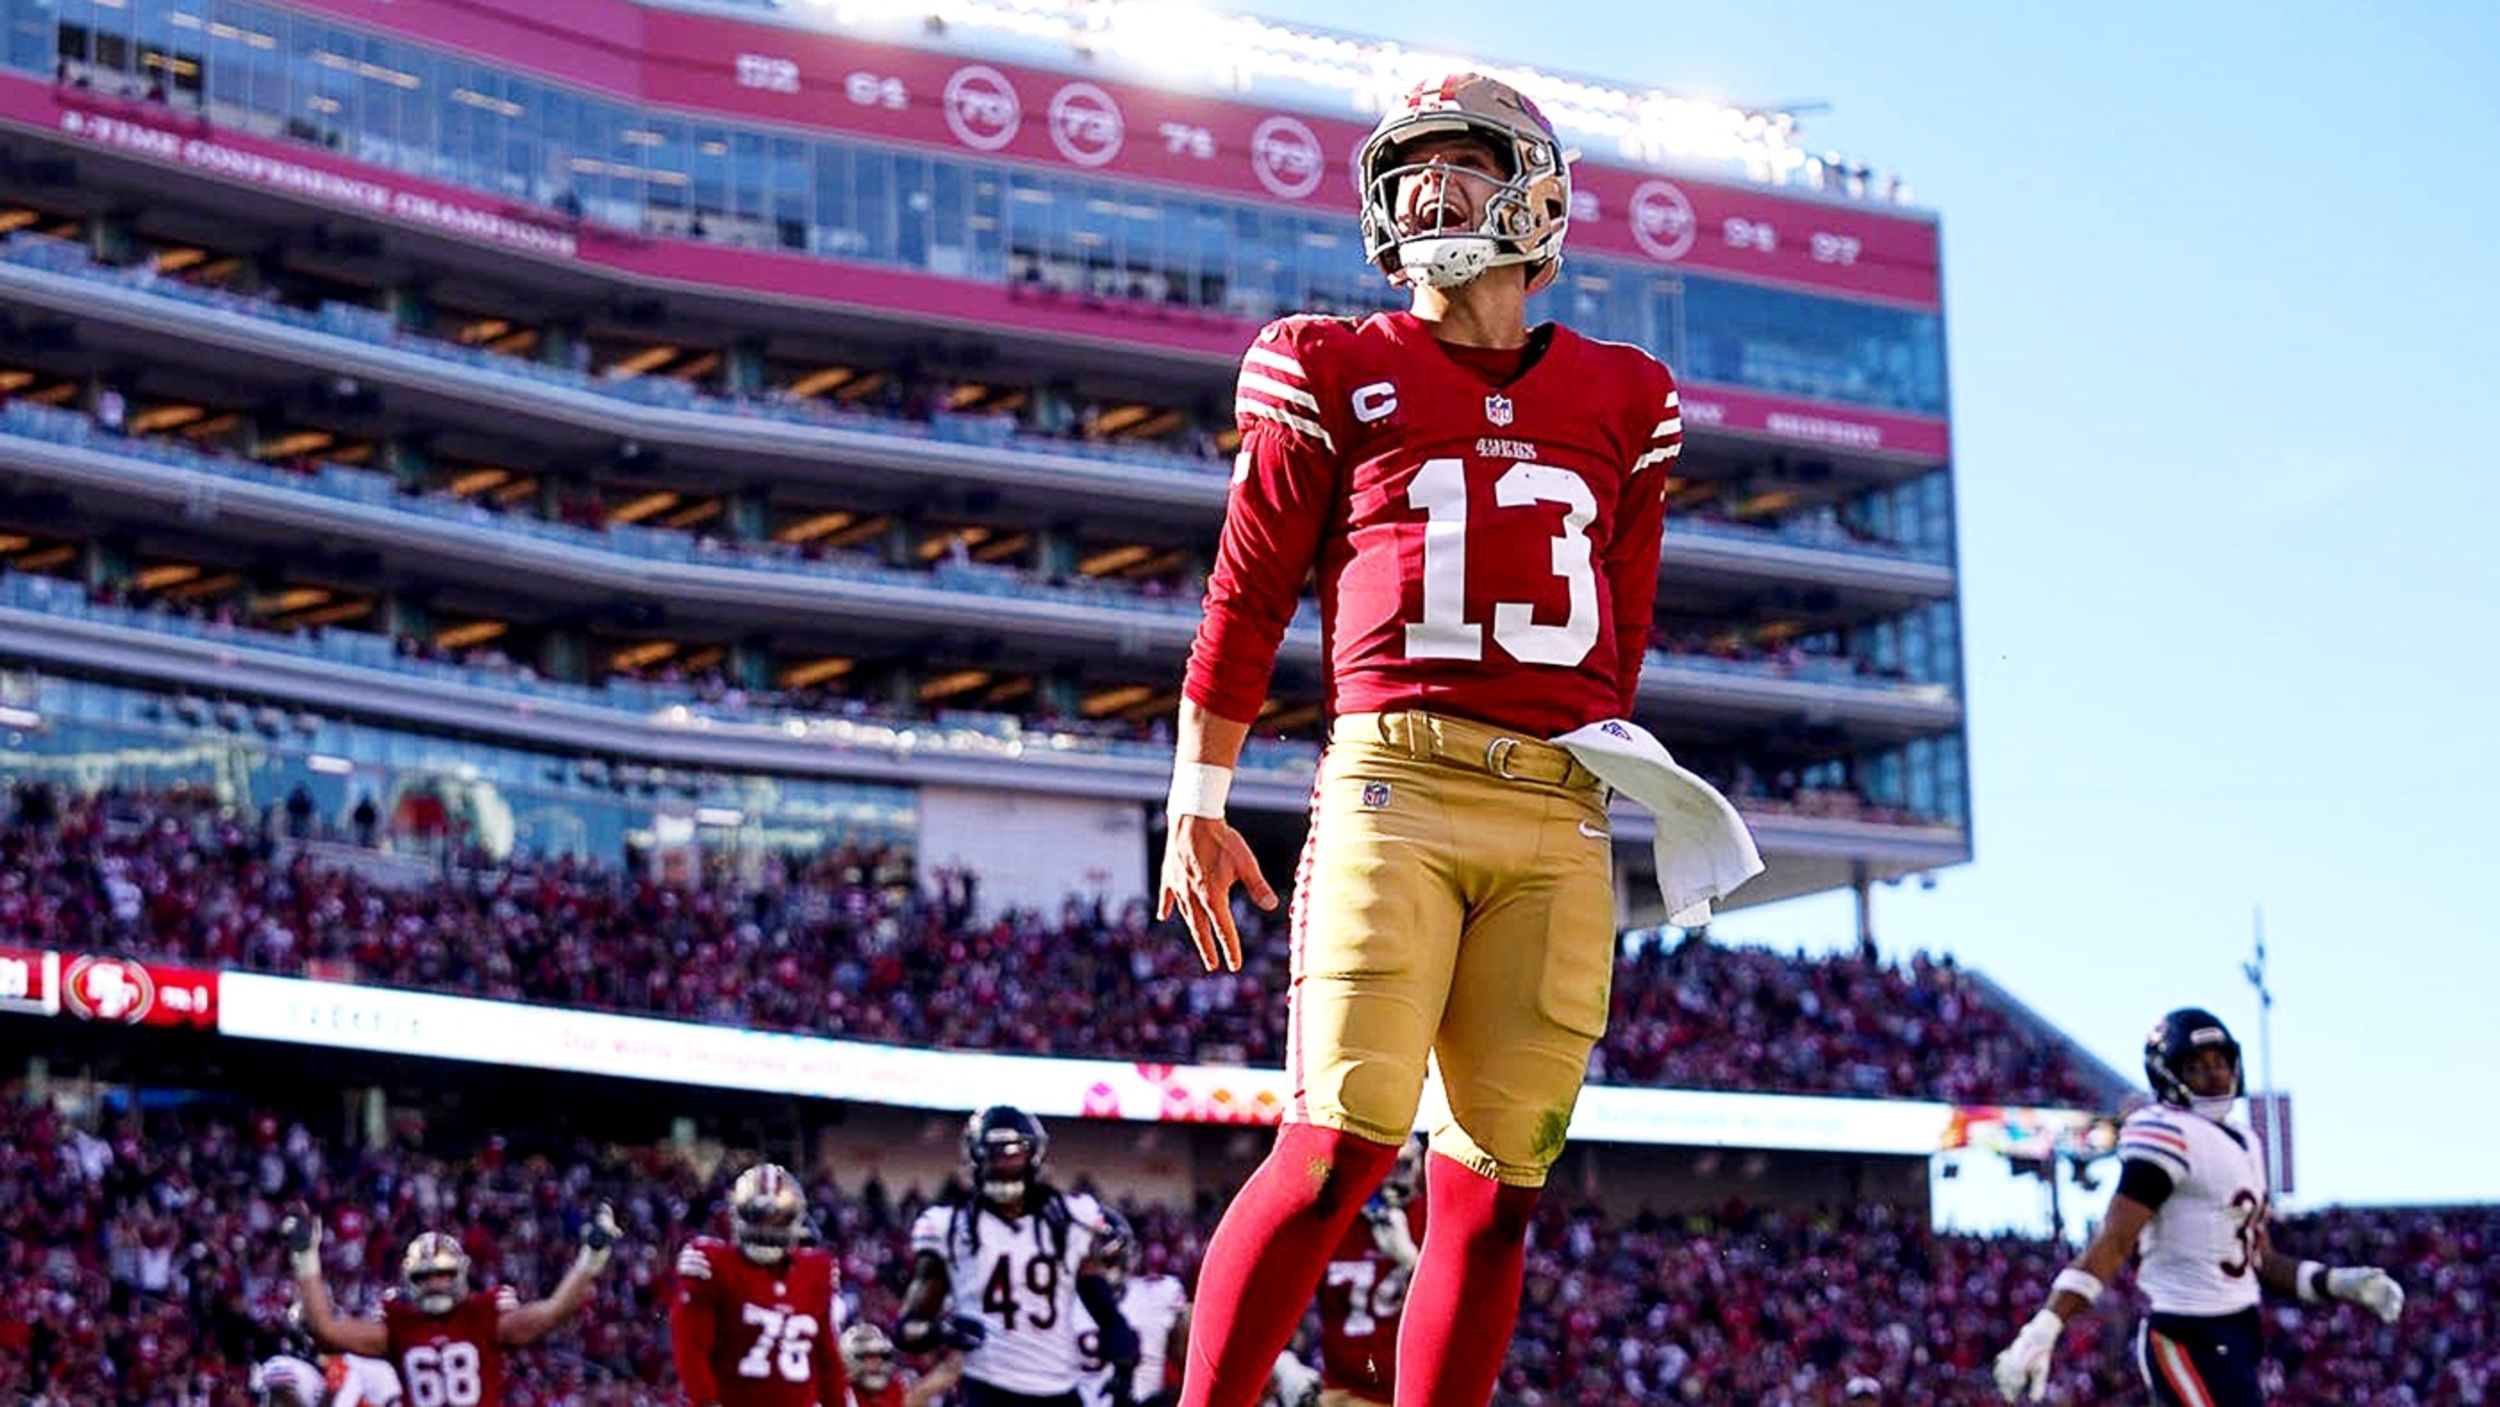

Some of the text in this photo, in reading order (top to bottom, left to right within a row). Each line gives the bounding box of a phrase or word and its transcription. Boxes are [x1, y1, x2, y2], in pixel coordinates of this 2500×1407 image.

[1352, 382, 1397, 422] C
[1405, 458, 1600, 667] 13
[983, 1254, 1057, 1330] 49
[404, 1341, 481, 1407] 68
[738, 1303, 819, 1382] 76
